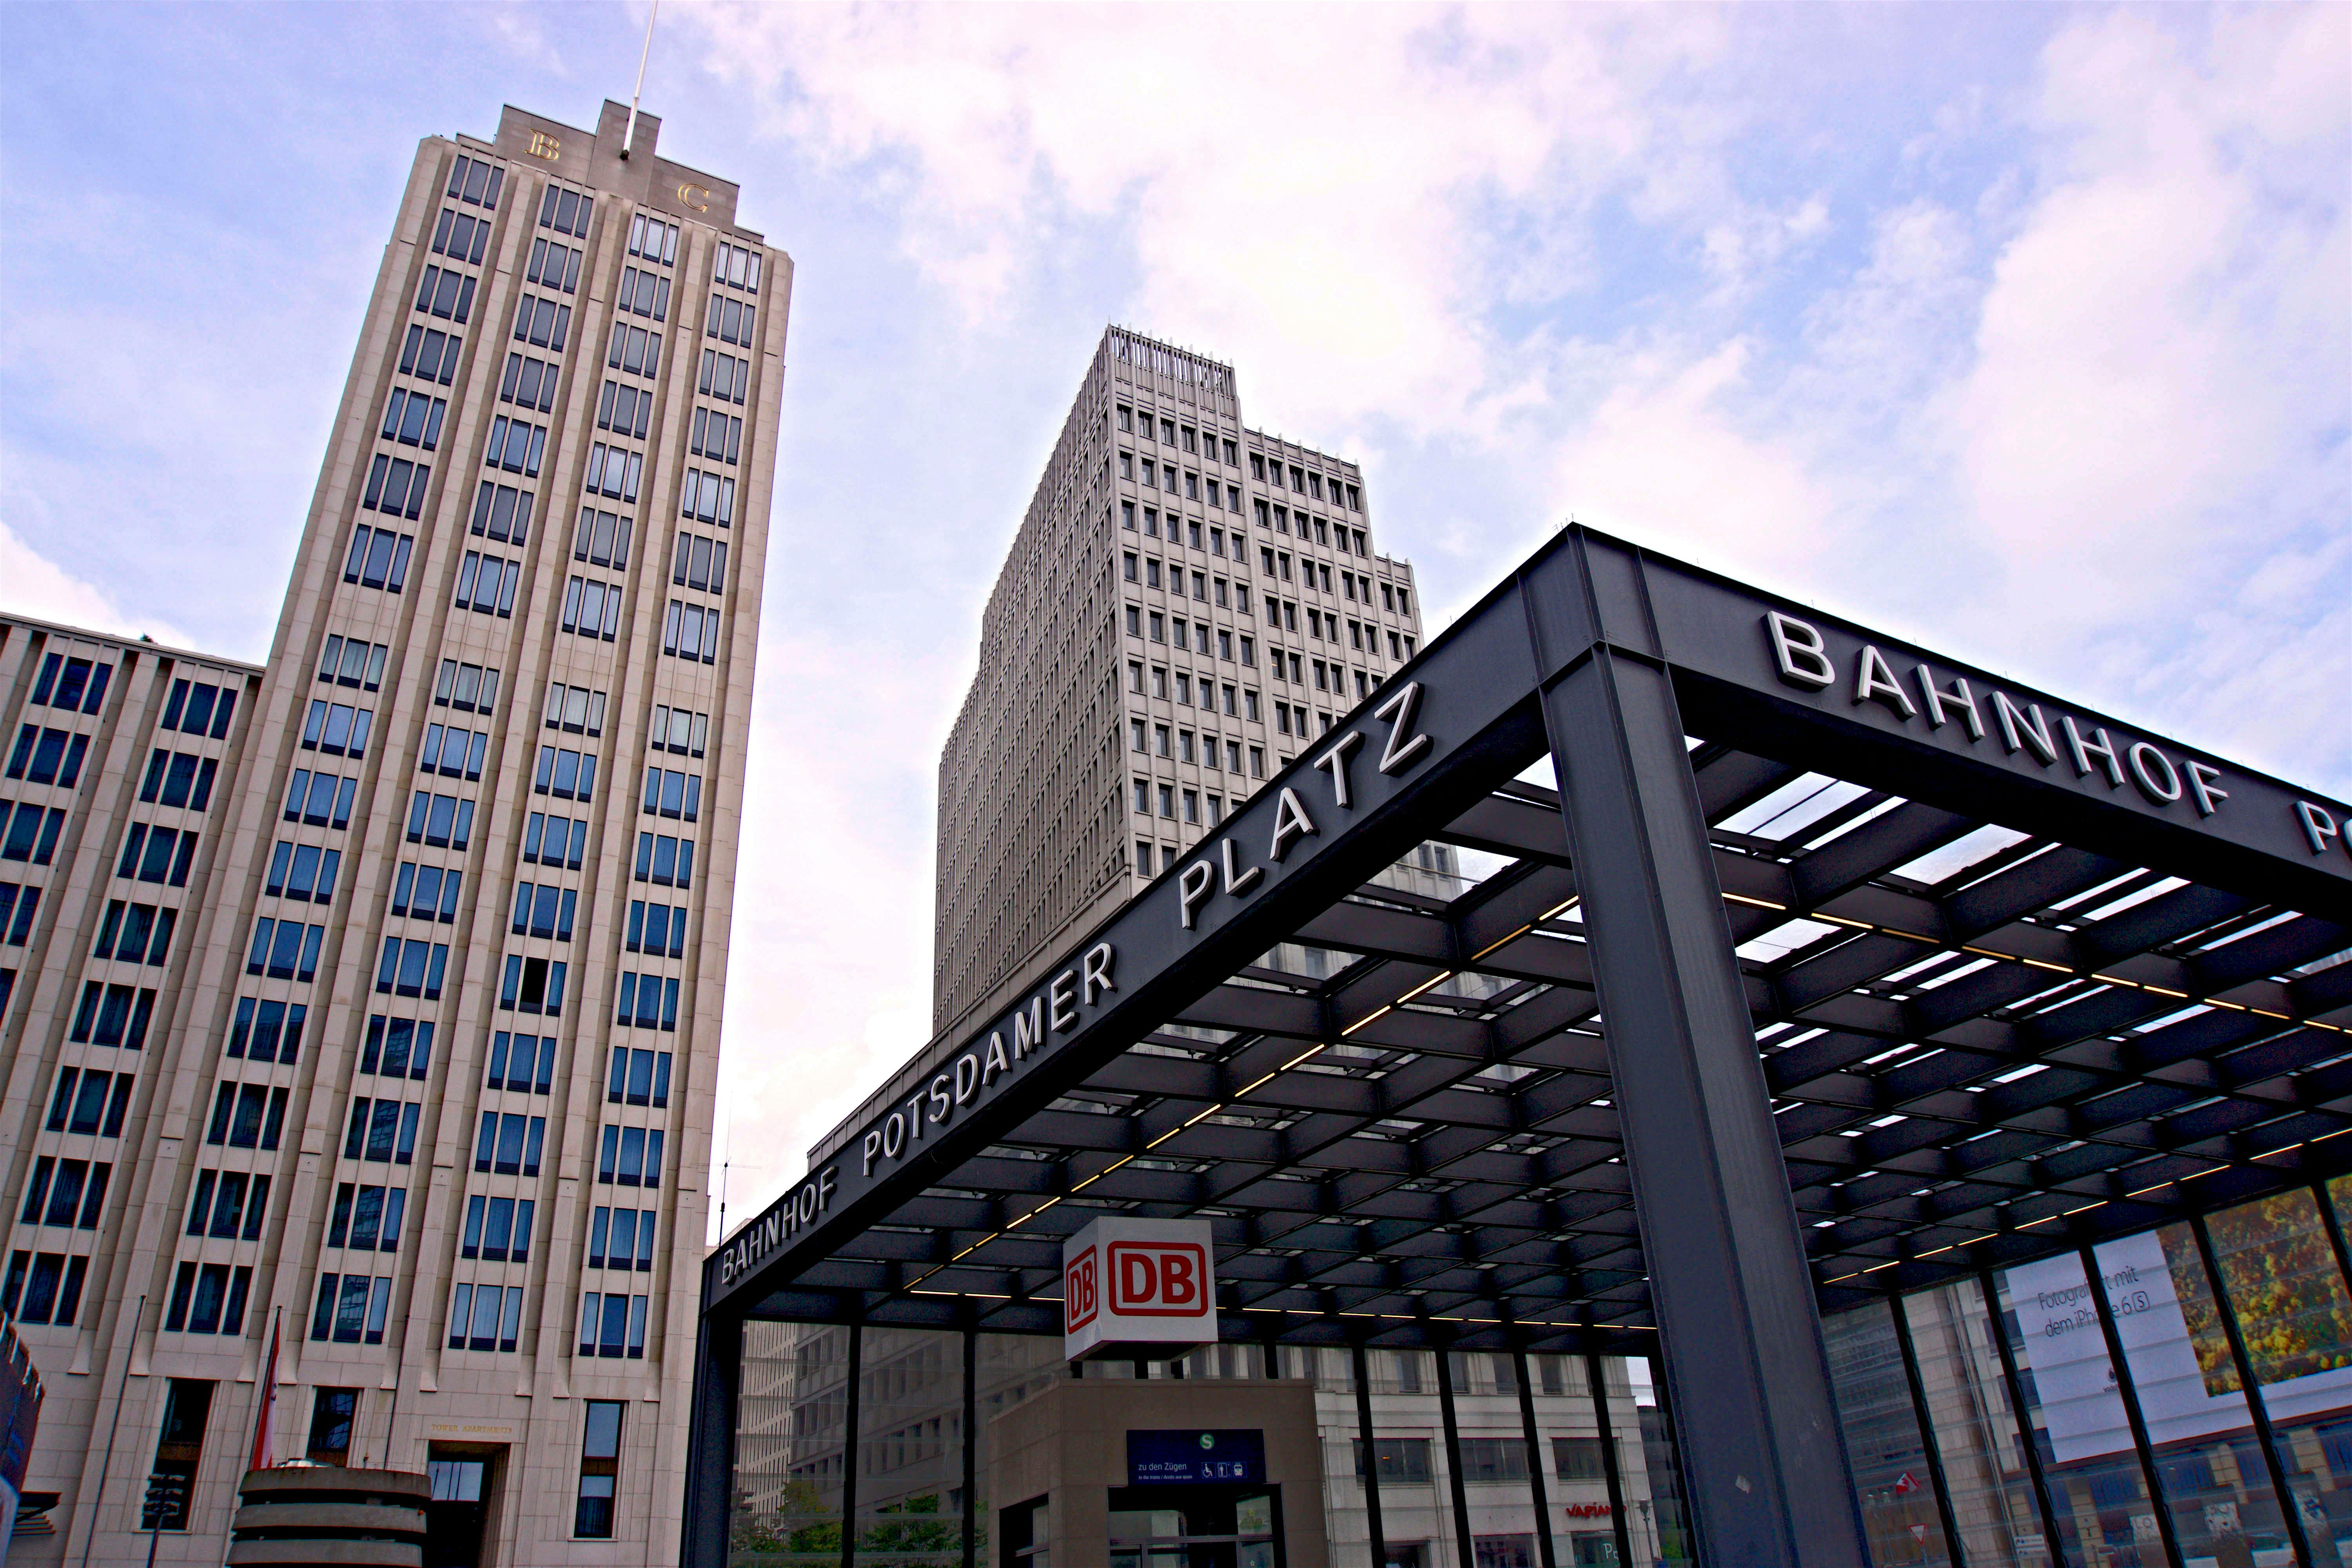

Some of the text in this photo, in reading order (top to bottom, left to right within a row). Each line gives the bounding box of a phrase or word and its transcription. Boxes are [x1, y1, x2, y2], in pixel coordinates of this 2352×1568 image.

[524, 129, 709, 212] B C
[1766, 610, 2352, 851] BAHNHOF P
[722, 681, 1427, 1285] BAHNHOF POTSDAMER PLATZ
[1070, 1260, 1094, 1321] DB
[1121, 1253, 1196, 1304] DB
[2114, 1266, 2139, 1287] mit
[2045, 1318, 2074, 1337] dem
[1149, 1462, 1163, 1471] den
[1164, 1462, 1187, 1472] Zügen
